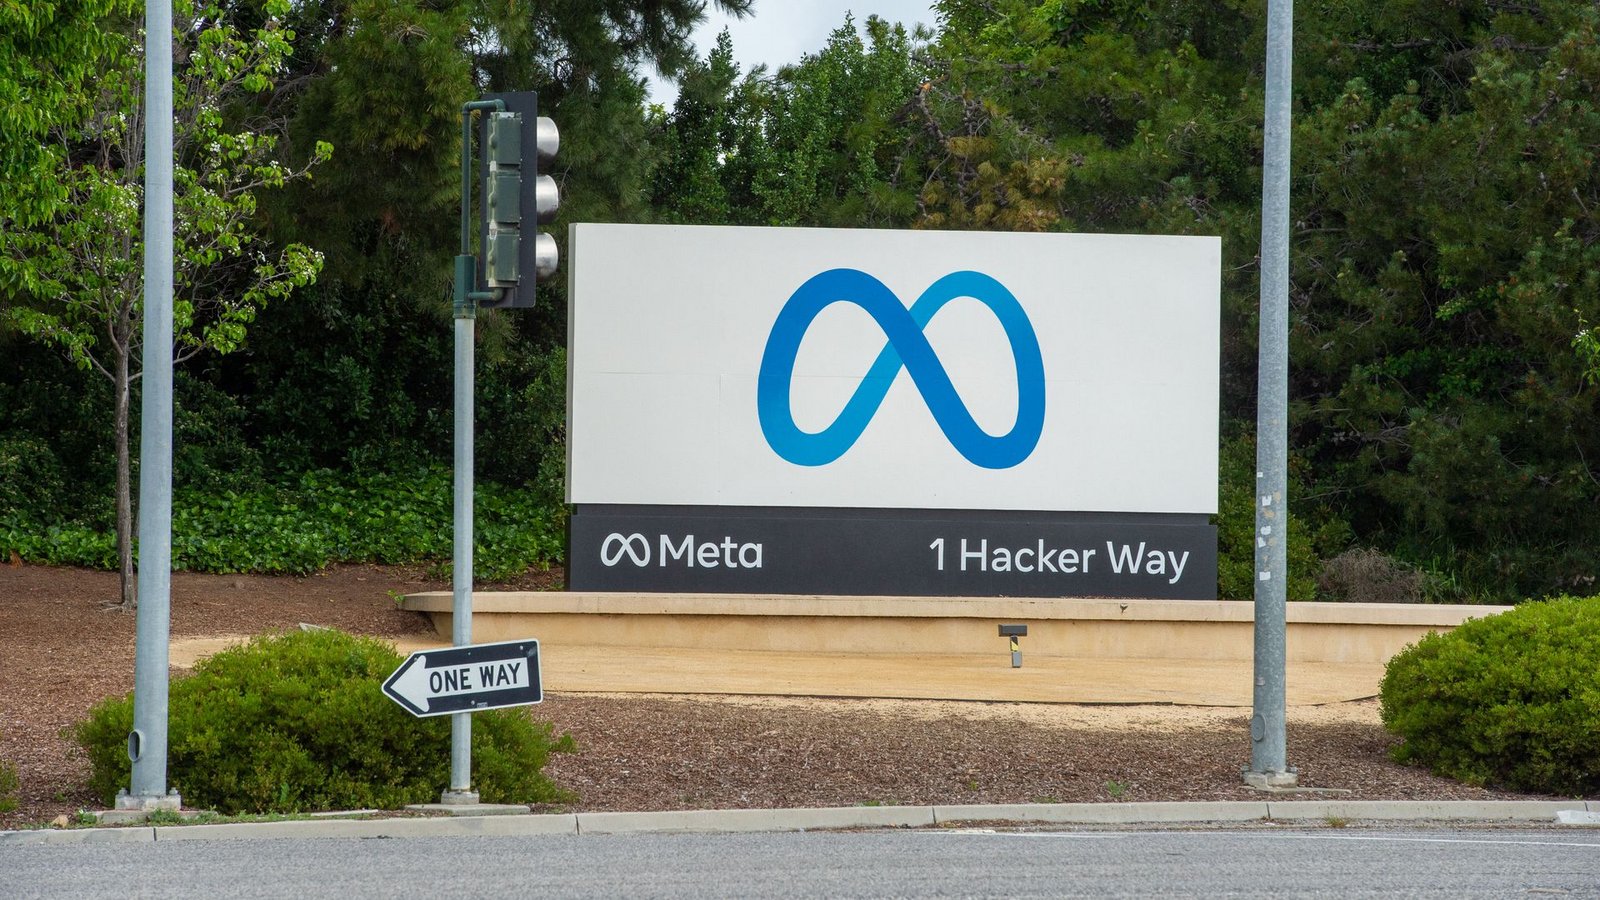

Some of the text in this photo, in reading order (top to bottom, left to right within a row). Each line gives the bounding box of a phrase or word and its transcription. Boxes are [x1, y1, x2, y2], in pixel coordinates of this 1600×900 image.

[659, 534, 763, 569] Meta
[929, 537, 1190, 585] 1 Hacker Way
[429, 662, 521, 694] ONE WAY
